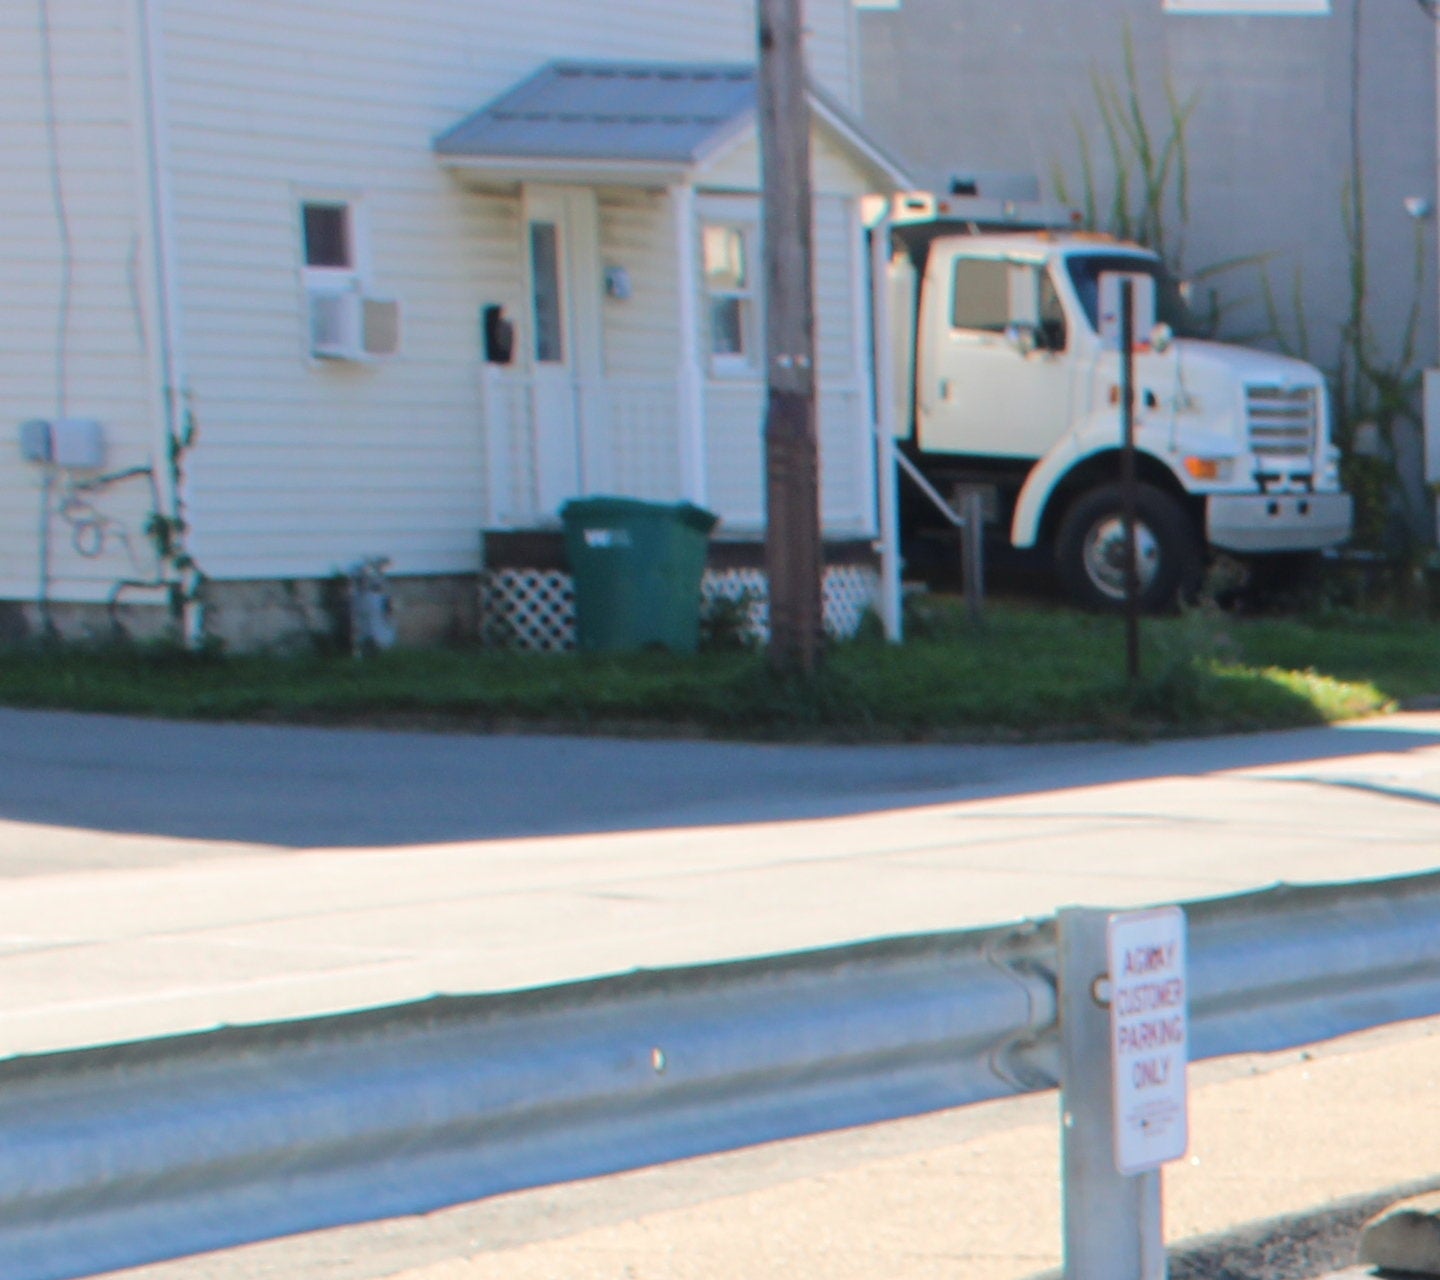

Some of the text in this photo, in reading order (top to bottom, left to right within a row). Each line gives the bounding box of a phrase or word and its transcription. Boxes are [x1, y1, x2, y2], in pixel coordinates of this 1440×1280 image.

[1117, 978, 1184, 1017] CUSTOMER
[1118, 1014, 1184, 1053] PARKING
[1133, 1056, 1171, 1090] ONLY
